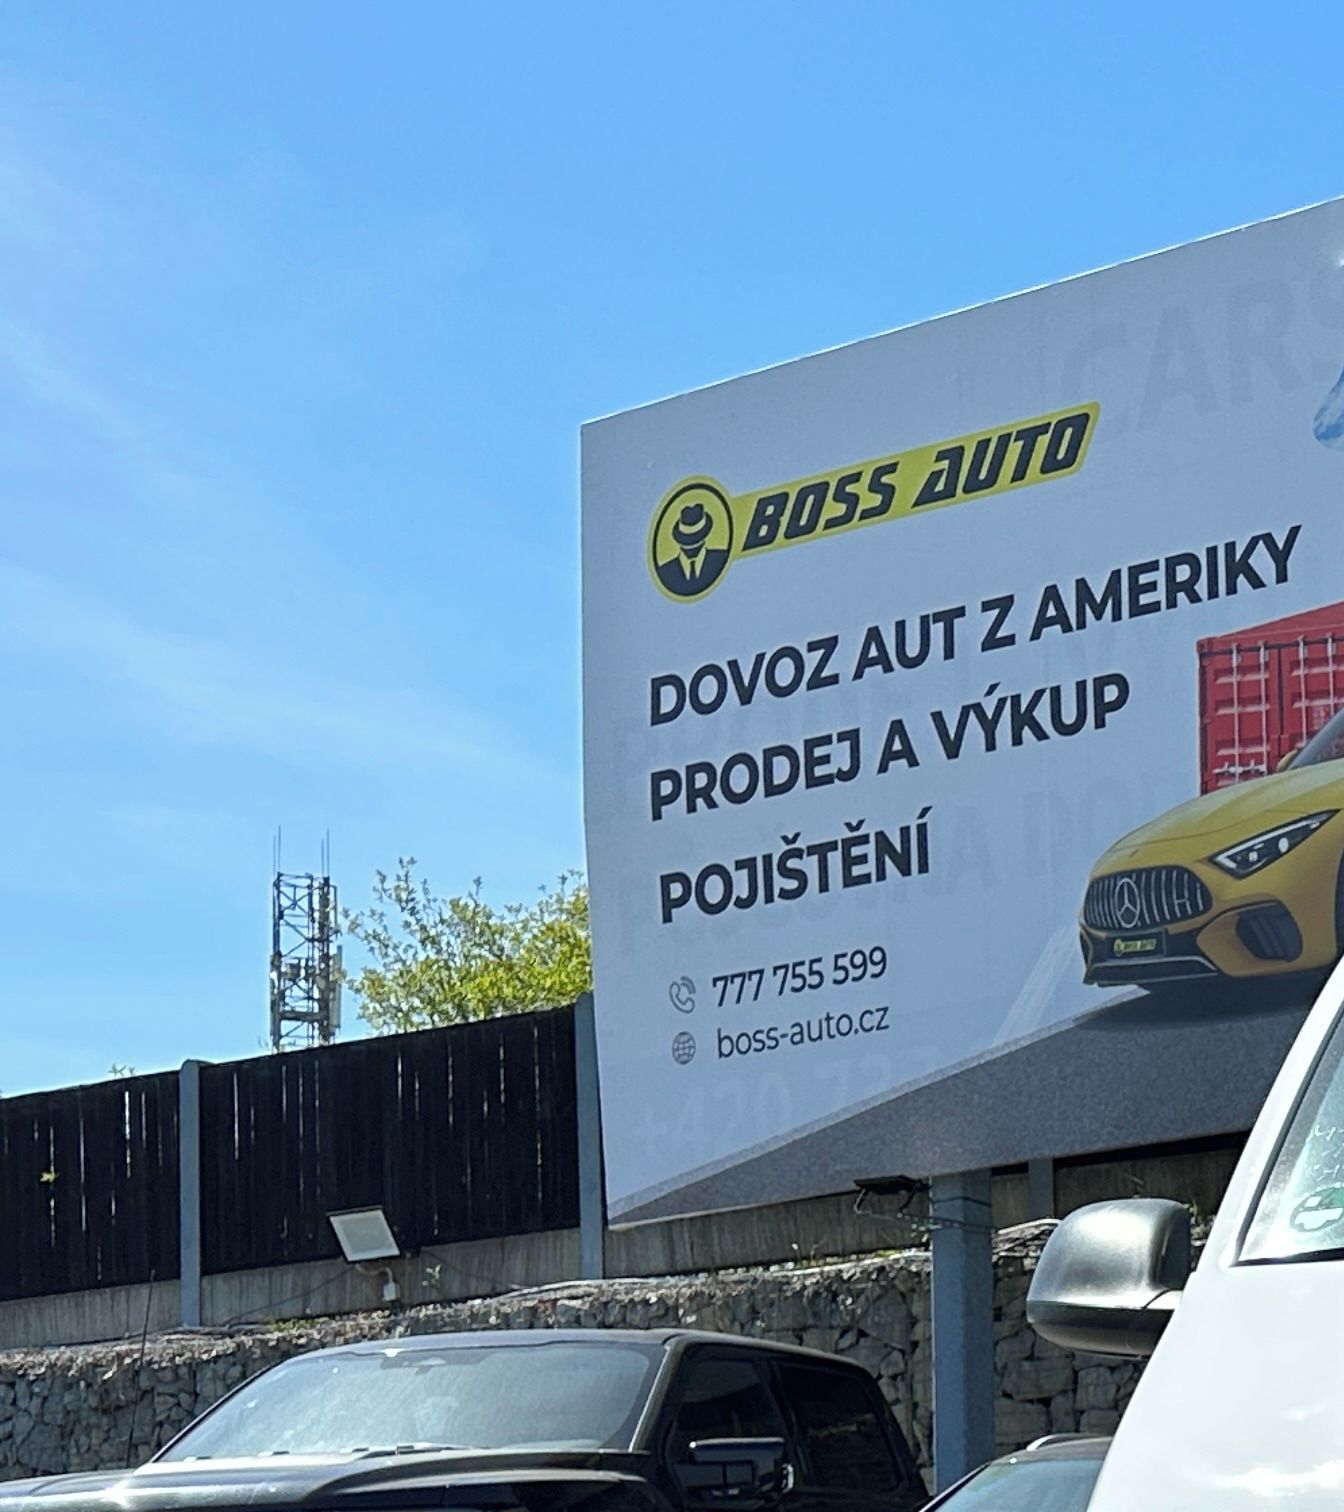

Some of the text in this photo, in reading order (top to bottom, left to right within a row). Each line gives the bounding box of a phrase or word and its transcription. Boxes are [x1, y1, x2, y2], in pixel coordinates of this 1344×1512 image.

[742, 412, 1090, 552] BOSS AUTO
[650, 524, 1302, 727] DOVOZ AUT Z AMERIKY
[651, 672, 1130, 821] PRODEJ A VÝKUP
[660, 806, 933, 924] POJIŠTĚNÍ
[712, 946, 888, 1008] 777 755 599
[717, 1006, 890, 1059] boss-auto.cz
